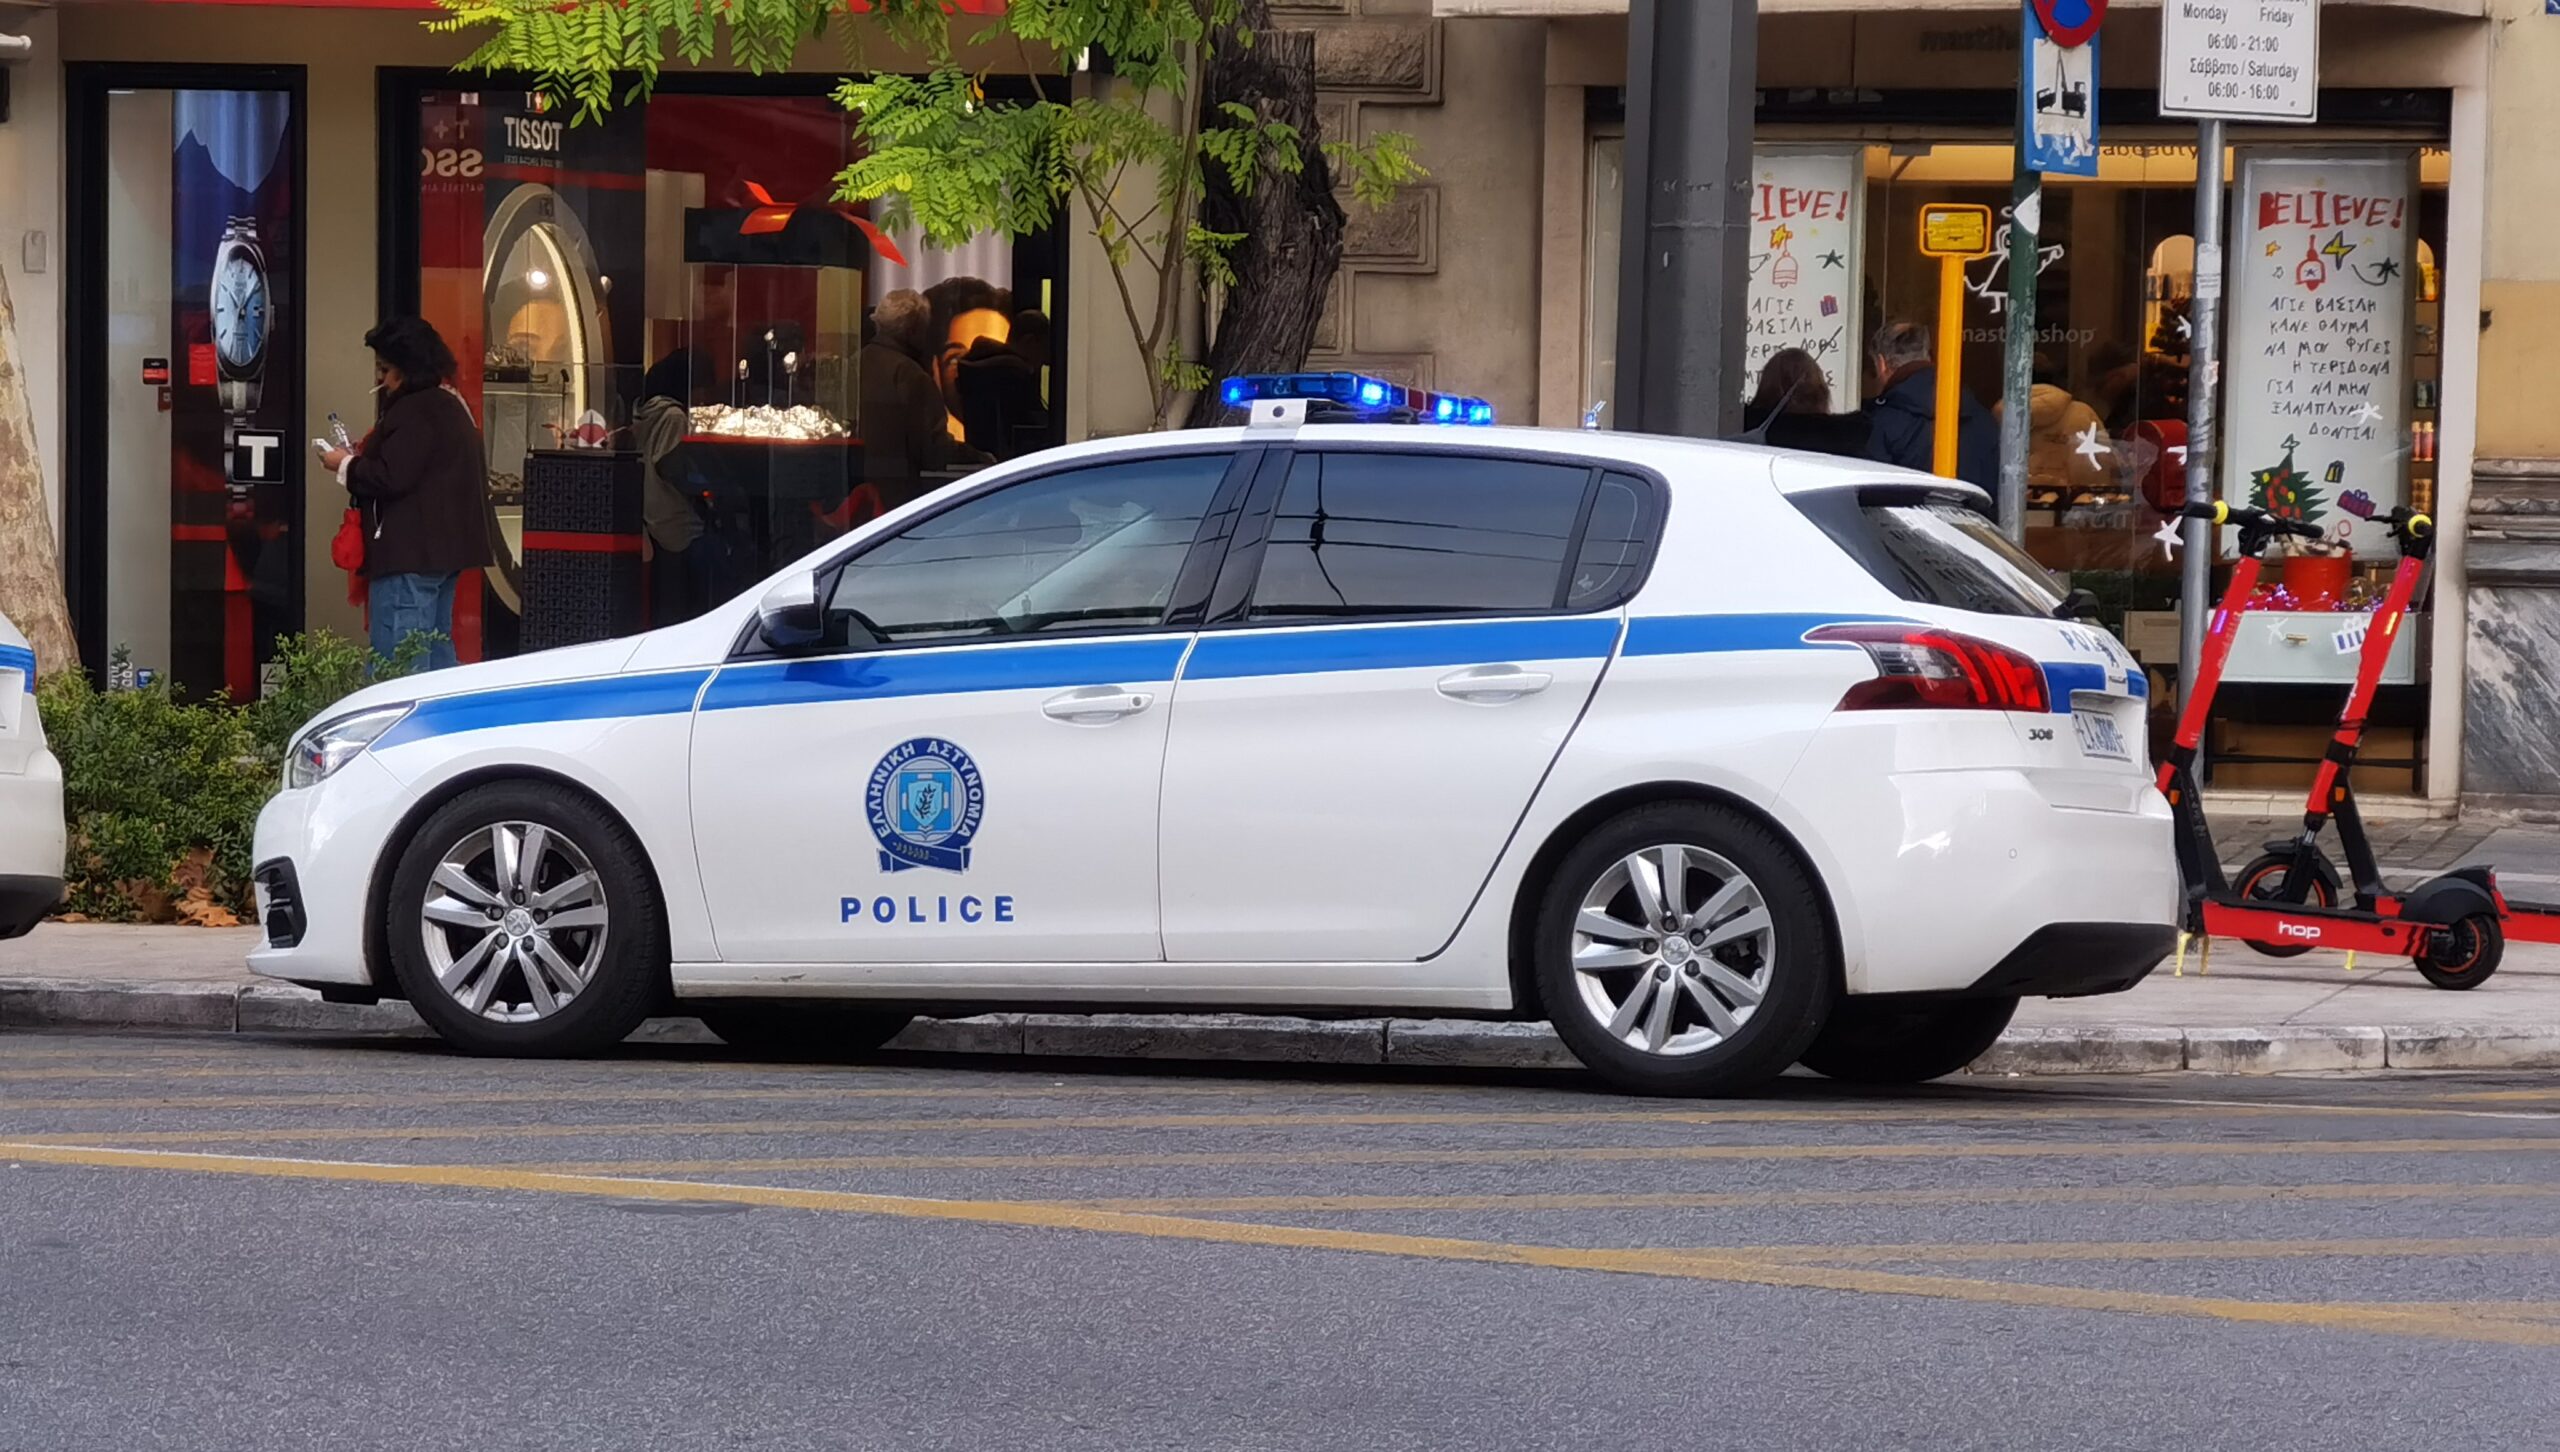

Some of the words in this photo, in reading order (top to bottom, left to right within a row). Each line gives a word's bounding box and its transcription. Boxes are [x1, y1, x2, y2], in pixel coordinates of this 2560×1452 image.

[2183, 3, 2228, 24] Monday
[2259, 6, 2295, 28] Friday
[2207, 33, 2239, 50] 06:00
[2248, 35, 2280, 52] 21:00
[2248, 60, 2299, 82] Saturday
[2208, 81, 2239, 98] 06:00
[2249, 83, 2280, 100] 16:00
[503, 116, 563, 152] TISSOT
[2258, 190, 2405, 231] BELIEVE!
[238, 435, 279, 478] T
[2028, 728, 2054, 741] 308
[868, 742, 916, 839] ΕΛΛΗΝΙΚΗ
[926, 740, 983, 838] ΑΣΤΥΝΟΜΙΑ
[840, 895, 1014, 924] POLICE
[2278, 920, 2321, 939] hop
